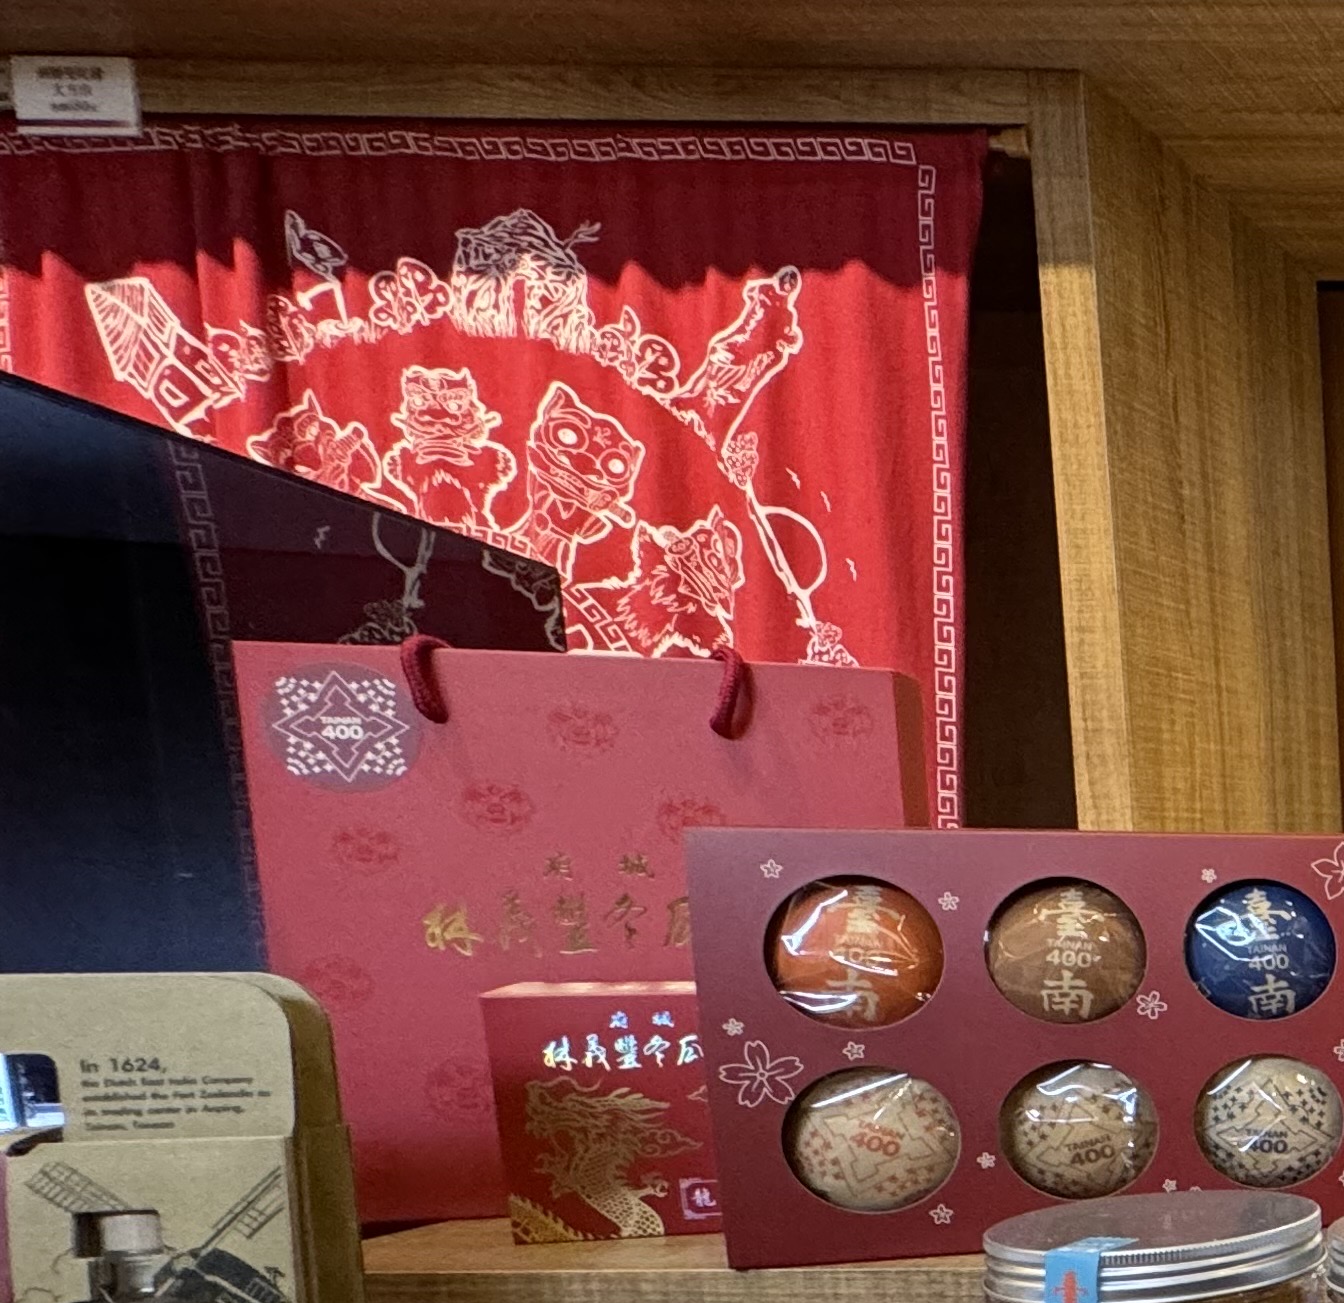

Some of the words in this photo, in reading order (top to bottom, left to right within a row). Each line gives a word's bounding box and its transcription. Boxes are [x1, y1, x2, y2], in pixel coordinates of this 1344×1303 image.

[321, 725, 365, 740] 400
[1037, 888, 1106, 939] 臺
[1046, 938, 1094, 952] TAINAN
[1046, 950, 1092, 968] 400
[1248, 955, 1290, 971] 400
[1040, 969, 1094, 1019] 南
[1248, 973, 1297, 1017] 南
[110, 1057, 168, 1074] 1624,
[1070, 1146, 1116, 1167] 400
